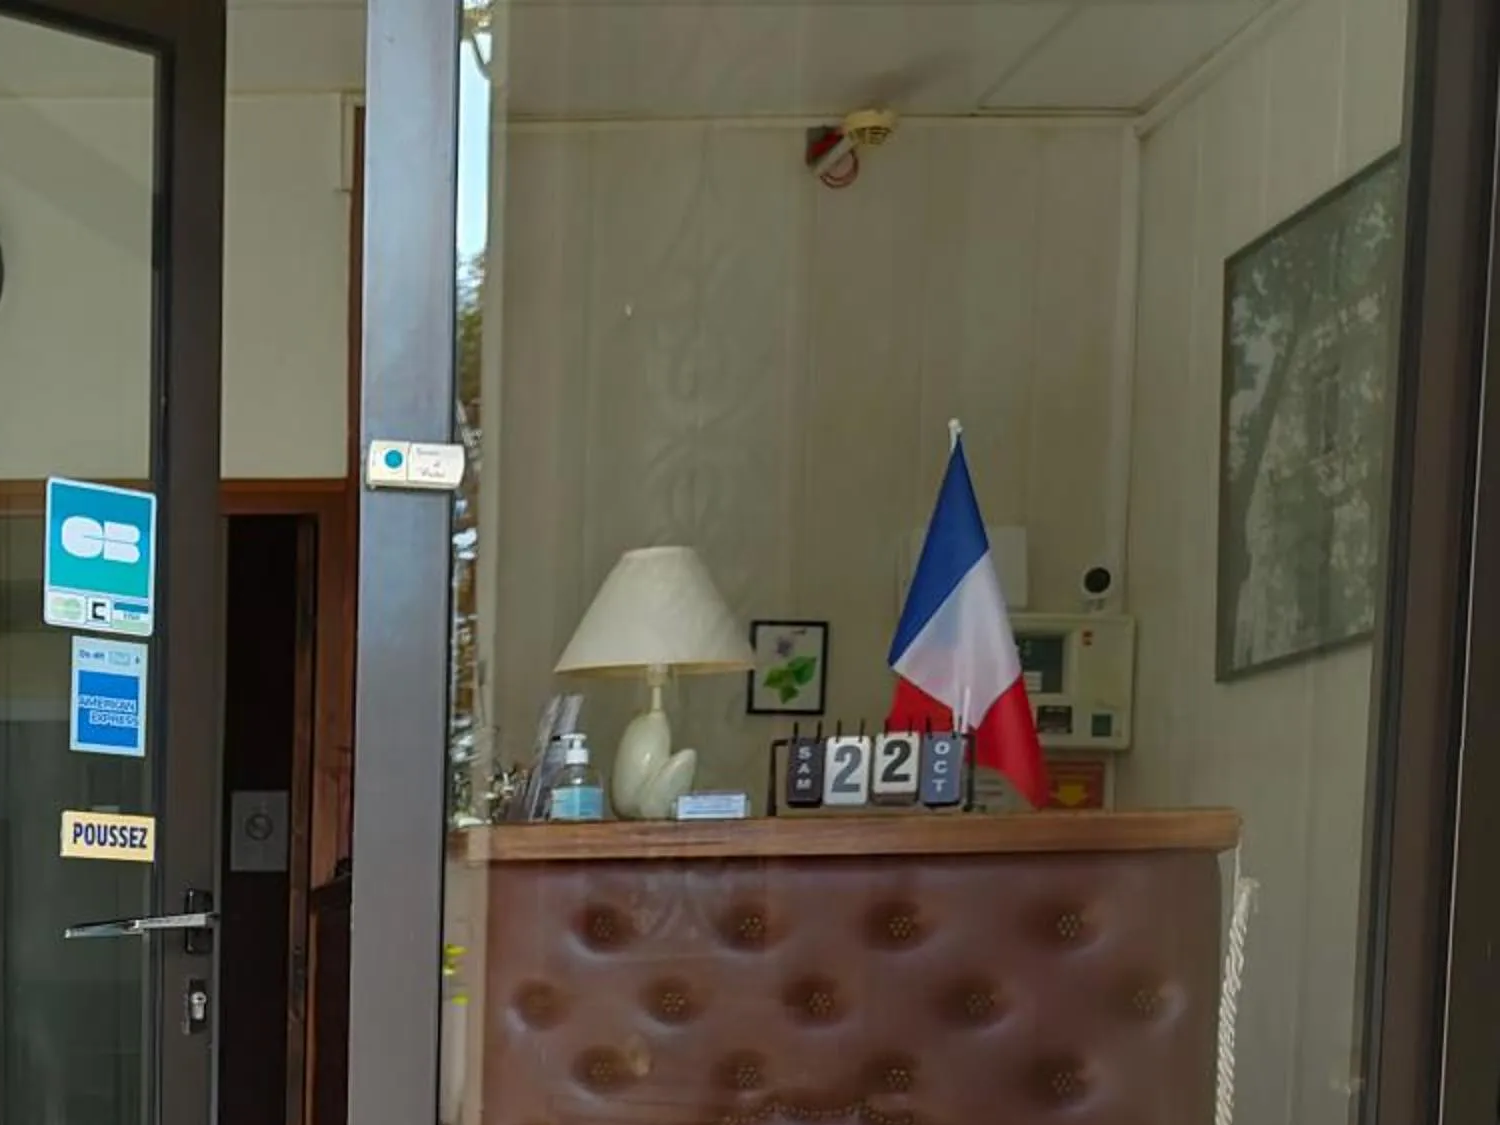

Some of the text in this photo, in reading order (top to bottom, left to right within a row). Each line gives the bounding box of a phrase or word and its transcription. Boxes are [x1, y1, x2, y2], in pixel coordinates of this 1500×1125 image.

[796, 746, 812, 790] SAM
[931, 740, 951, 792] OCT
[72, 821, 149, 848] POUSSEZ
